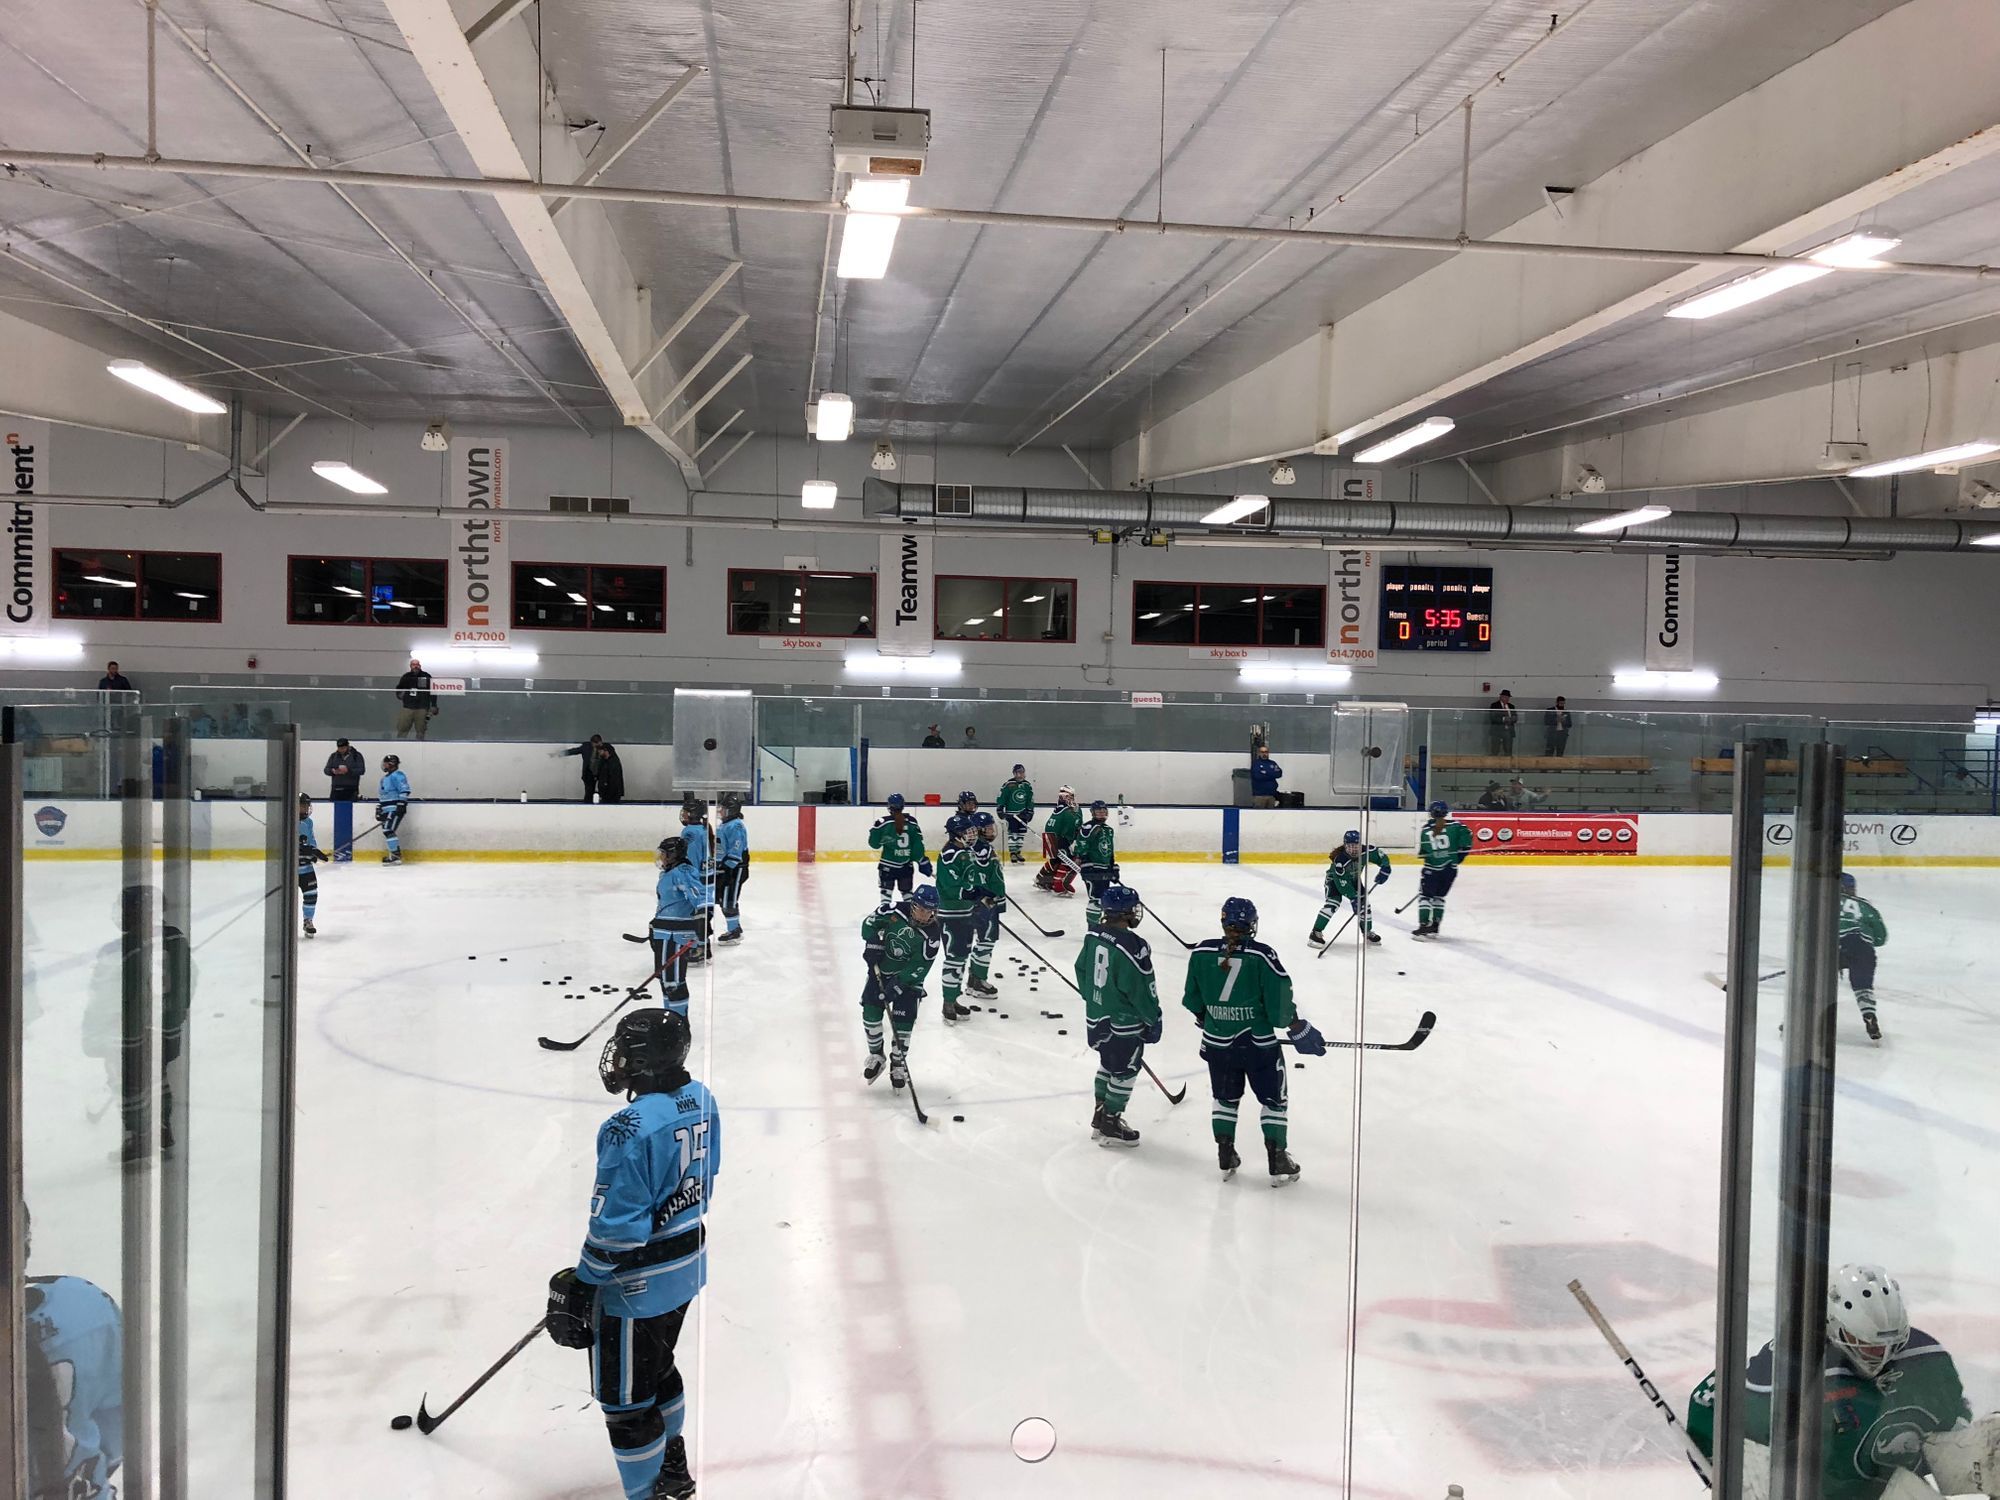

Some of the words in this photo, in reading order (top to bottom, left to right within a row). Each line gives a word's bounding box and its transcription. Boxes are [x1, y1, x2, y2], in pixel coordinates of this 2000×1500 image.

[1409, 583, 1434, 593] penalty
[1442, 584, 1467, 594] penalty
[1389, 610, 1408, 620] Home
[1425, 609, 1461, 628] 5:35
[1466, 612, 1489, 622] Guests
[1399, 621, 1410, 640] 0
[1478, 623, 1490, 641] 0
[454, 631, 506, 642] 614.7000
[783, 639, 797, 648] sky
[799, 639, 815, 647] box
[1426, 639, 1448, 648] period
[1210, 649, 1223, 658] sky
[1225, 649, 1239, 657] box
[1241, 649, 1248, 657] b
[1330, 650, 1375, 659] 614.7000
[432, 682, 463, 691] home
[1843, 821, 1884, 835] town
[1093, 944, 1110, 989] 8
[1217, 957, 1243, 1002] 7
[1206, 1005, 1255, 1021] MORRISETTE
